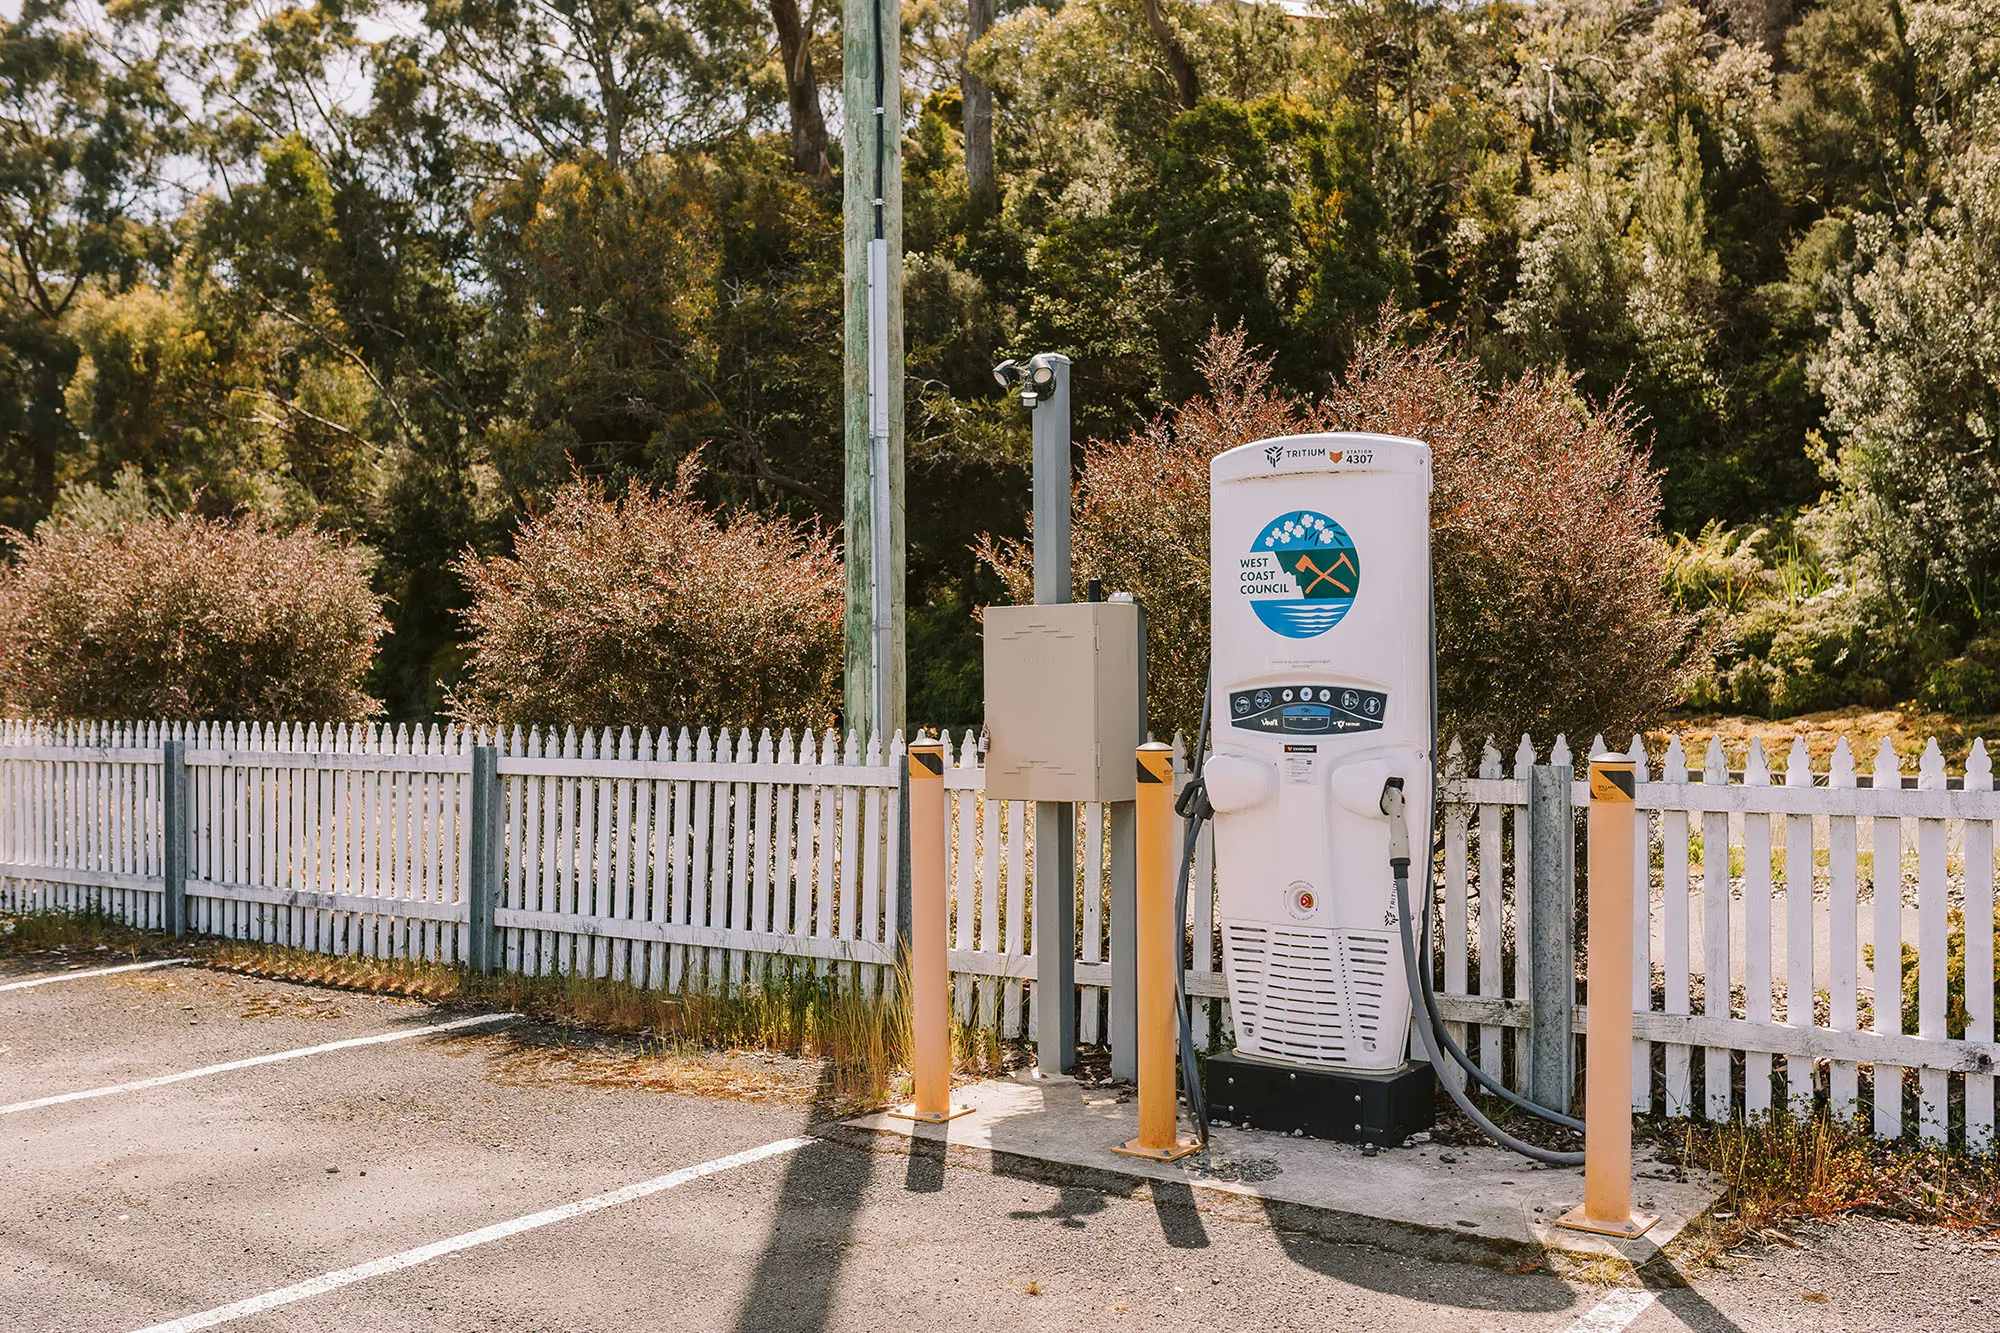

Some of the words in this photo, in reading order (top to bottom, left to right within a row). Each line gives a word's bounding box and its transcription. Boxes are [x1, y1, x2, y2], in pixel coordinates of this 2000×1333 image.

[1286, 448, 1326, 458] TRITIUM
[1346, 454, 1373, 464] 4307
[1240, 558, 1268, 568] WEST
[1240, 571, 1275, 581] COAST
[1240, 583, 1289, 594] COUNCIL
